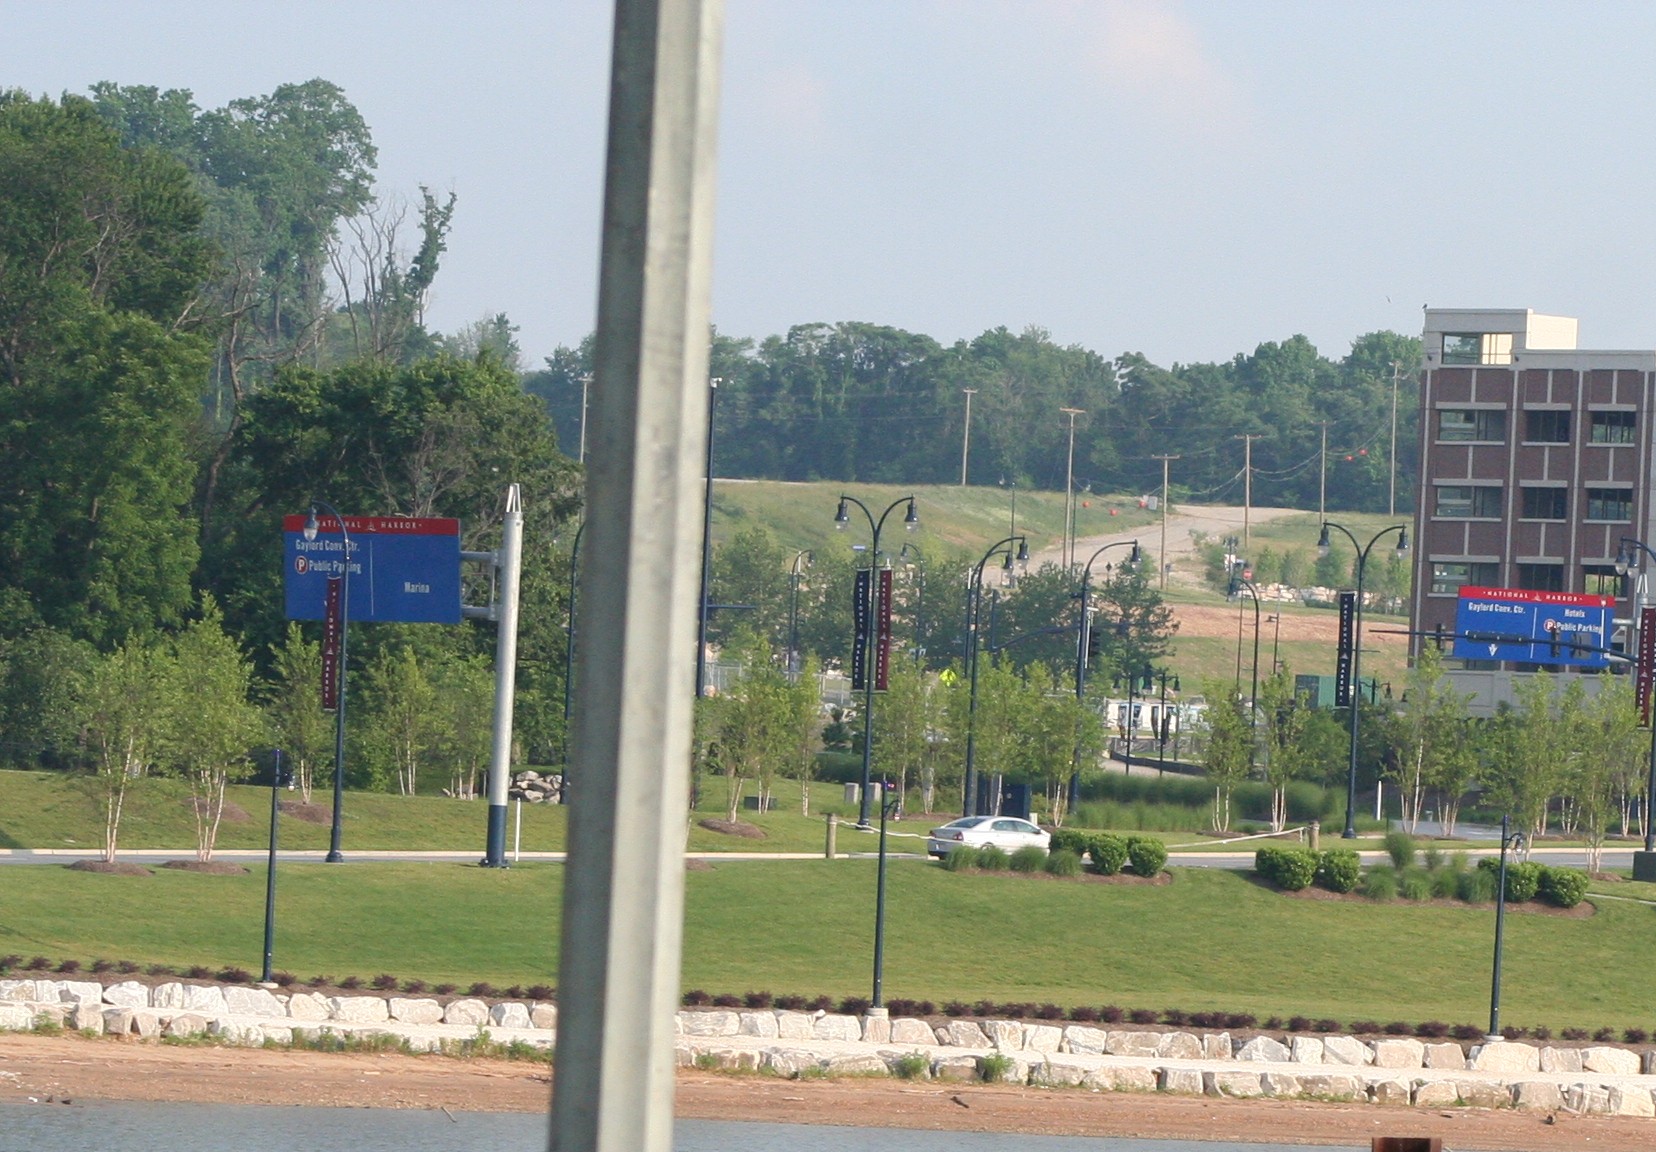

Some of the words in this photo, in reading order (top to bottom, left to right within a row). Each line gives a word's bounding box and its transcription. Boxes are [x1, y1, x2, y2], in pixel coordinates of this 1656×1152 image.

[308, 559, 332, 572] Public
[404, 581, 430, 594] Marina
[1487, 590, 1529, 599] NATIONAL
[1545, 594, 1578, 602] HARBOR
[1468, 601, 1494, 614] Gaylord
[1494, 603, 1513, 614] Conv.
[1557, 621, 1577, 632] Public
